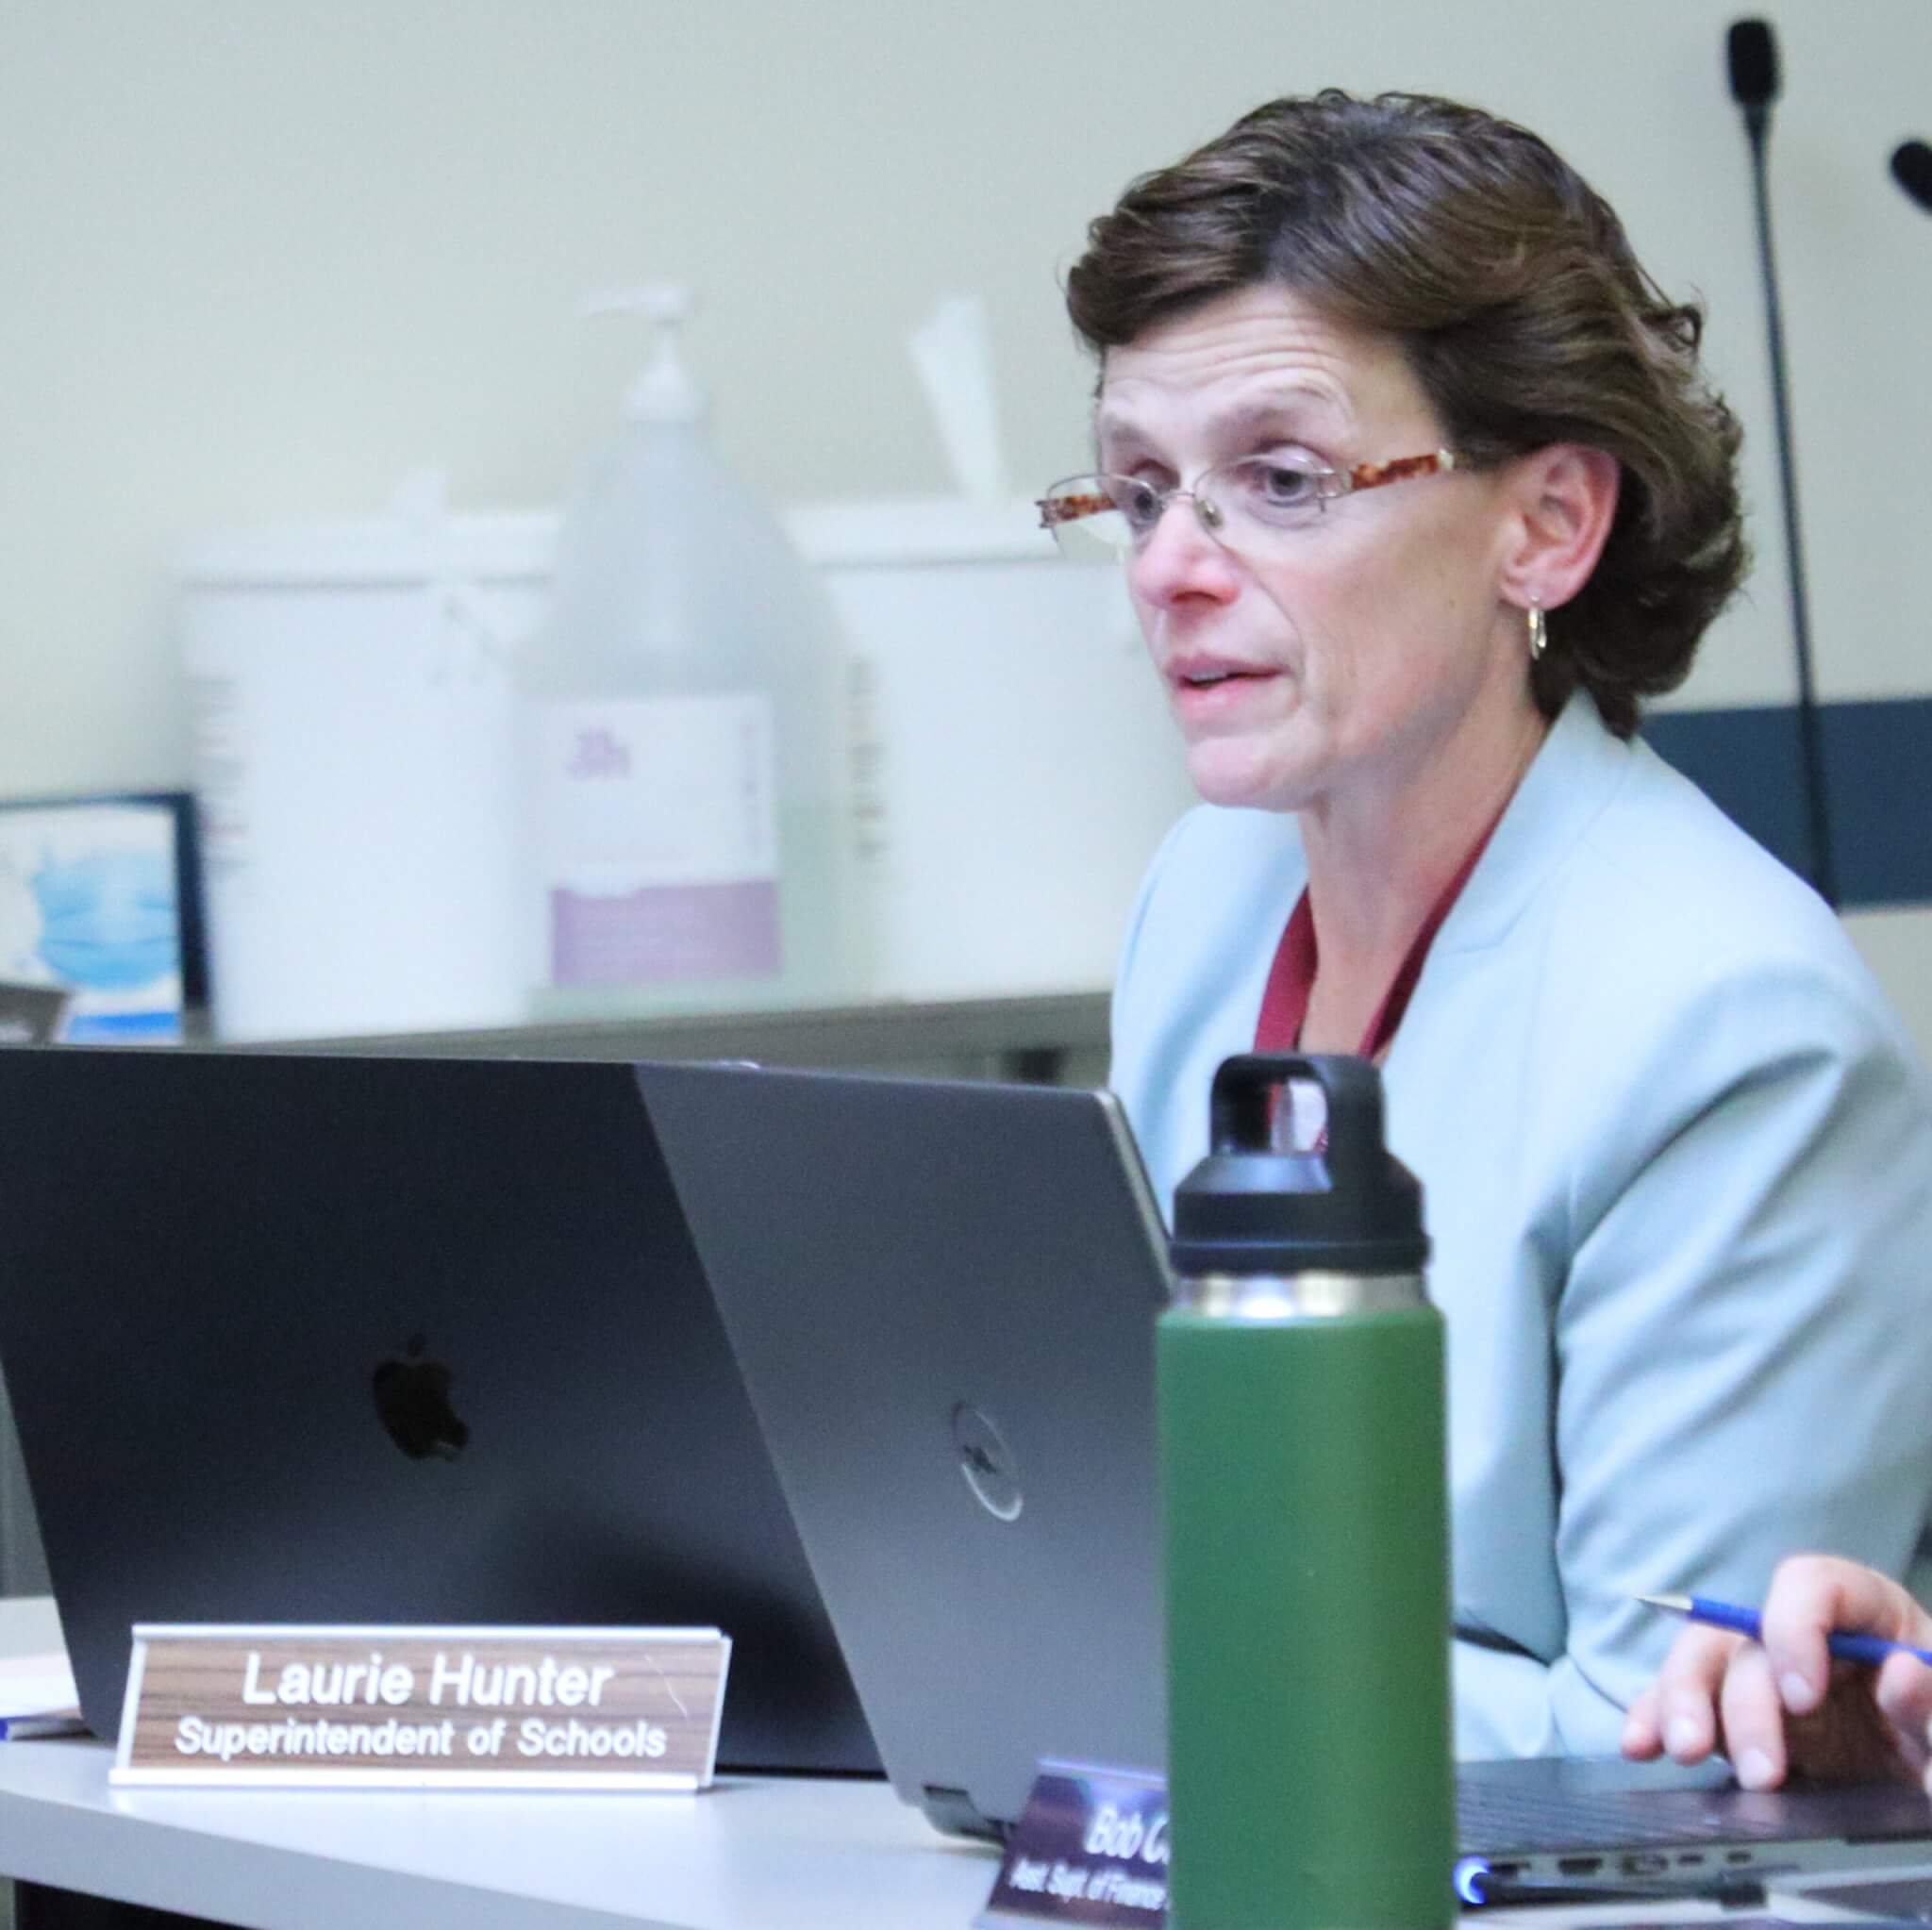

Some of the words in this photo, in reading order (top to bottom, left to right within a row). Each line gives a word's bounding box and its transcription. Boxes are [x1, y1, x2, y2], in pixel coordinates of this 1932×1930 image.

[242, 1651, 413, 1705] Laurie
[428, 1653, 615, 1705] Hunter
[176, 1714, 454, 1762] Superintendent
[467, 1718, 507, 1756] of
[517, 1716, 667, 1757] Schools
[1085, 1805, 1143, 1859] Bob
[1141, 1812, 1171, 1865] C
